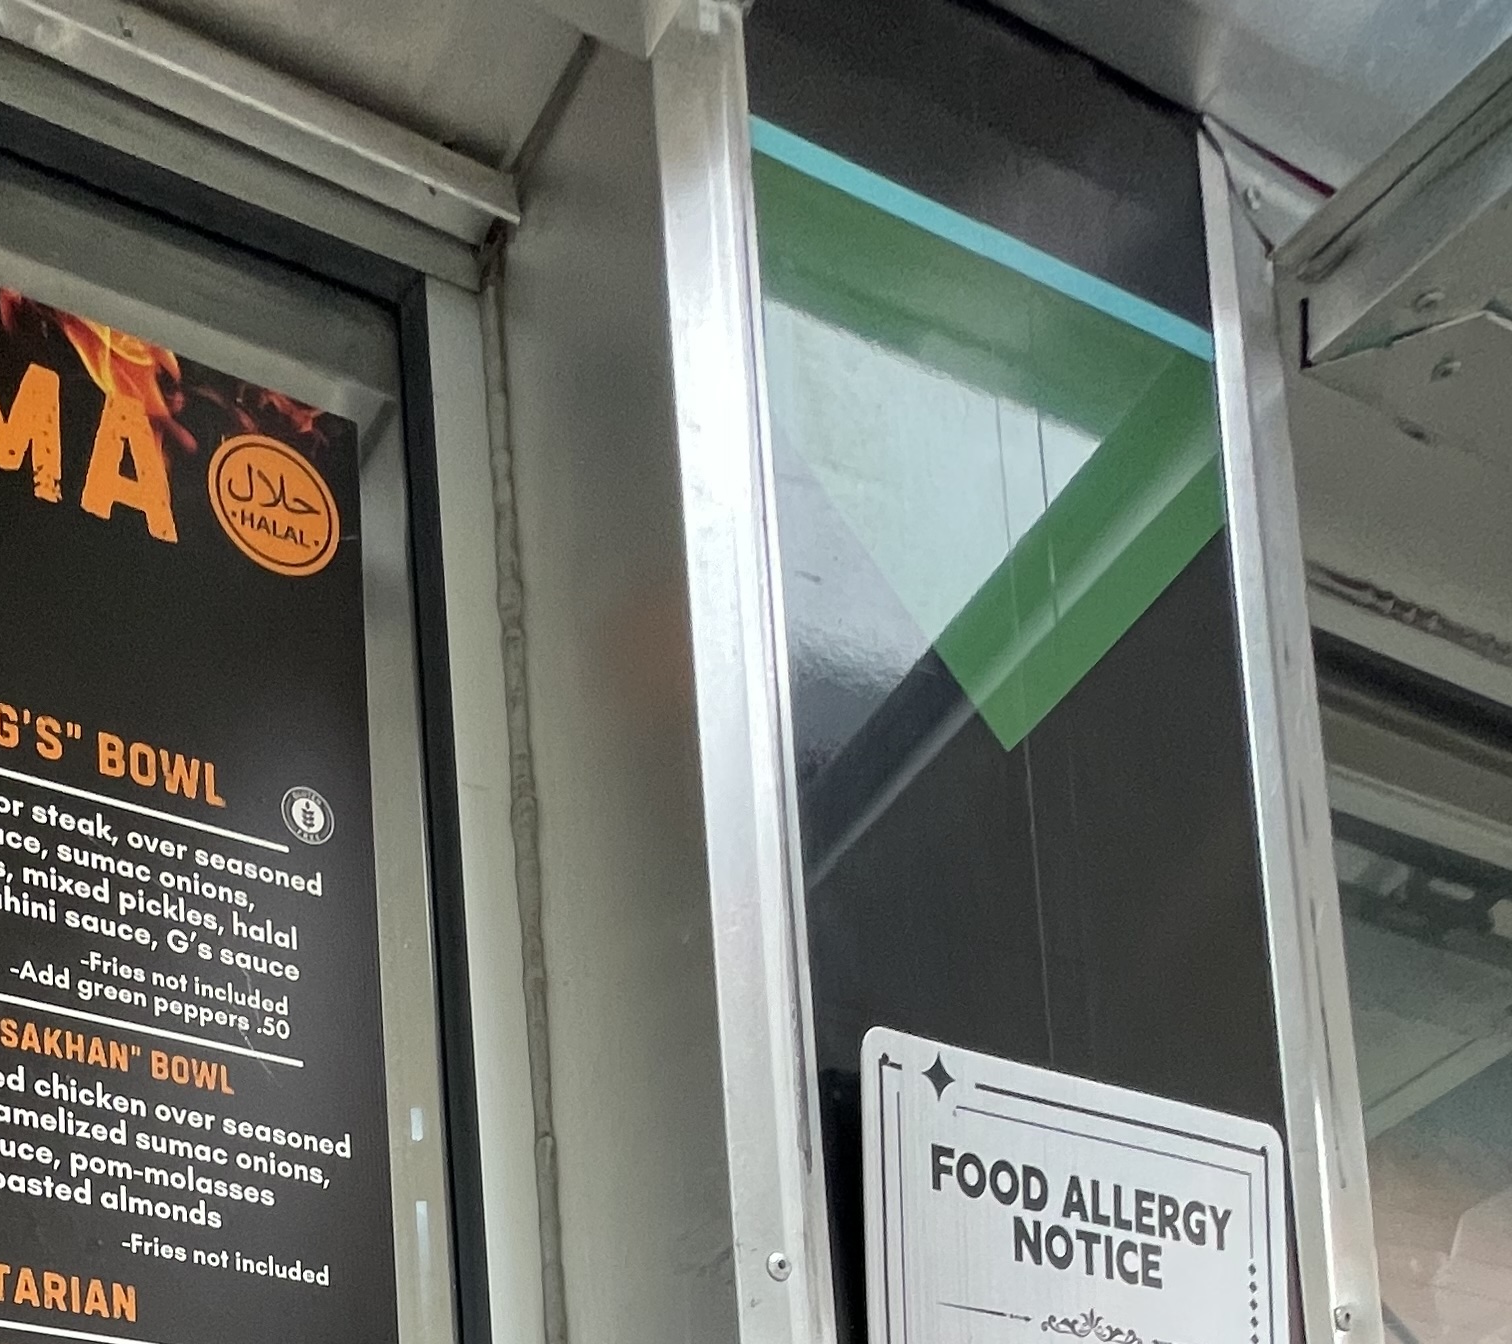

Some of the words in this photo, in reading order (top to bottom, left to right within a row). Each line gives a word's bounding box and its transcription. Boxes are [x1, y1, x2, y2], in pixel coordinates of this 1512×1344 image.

[228, 462, 320, 515] حلال
[240, 508, 311, 549] HALAL
[97, 731, 227, 809] BOWL
[150, 1049, 236, 1096] BOWL
[70, 1151, 276, 1207] pom-molasses
[135, 1132, 229, 1166] sumac
[235, 1151, 330, 1190] onions,
[930, 1143, 1049, 1212] FOOD
[1061, 1174, 1233, 1251] ALLERGY
[121, 1232, 188, 1262] -Fries
[192, 1249, 230, 1269] not
[234, 1251, 330, 1287] included
[1013, 1215, 1163, 1290] NOTICE
